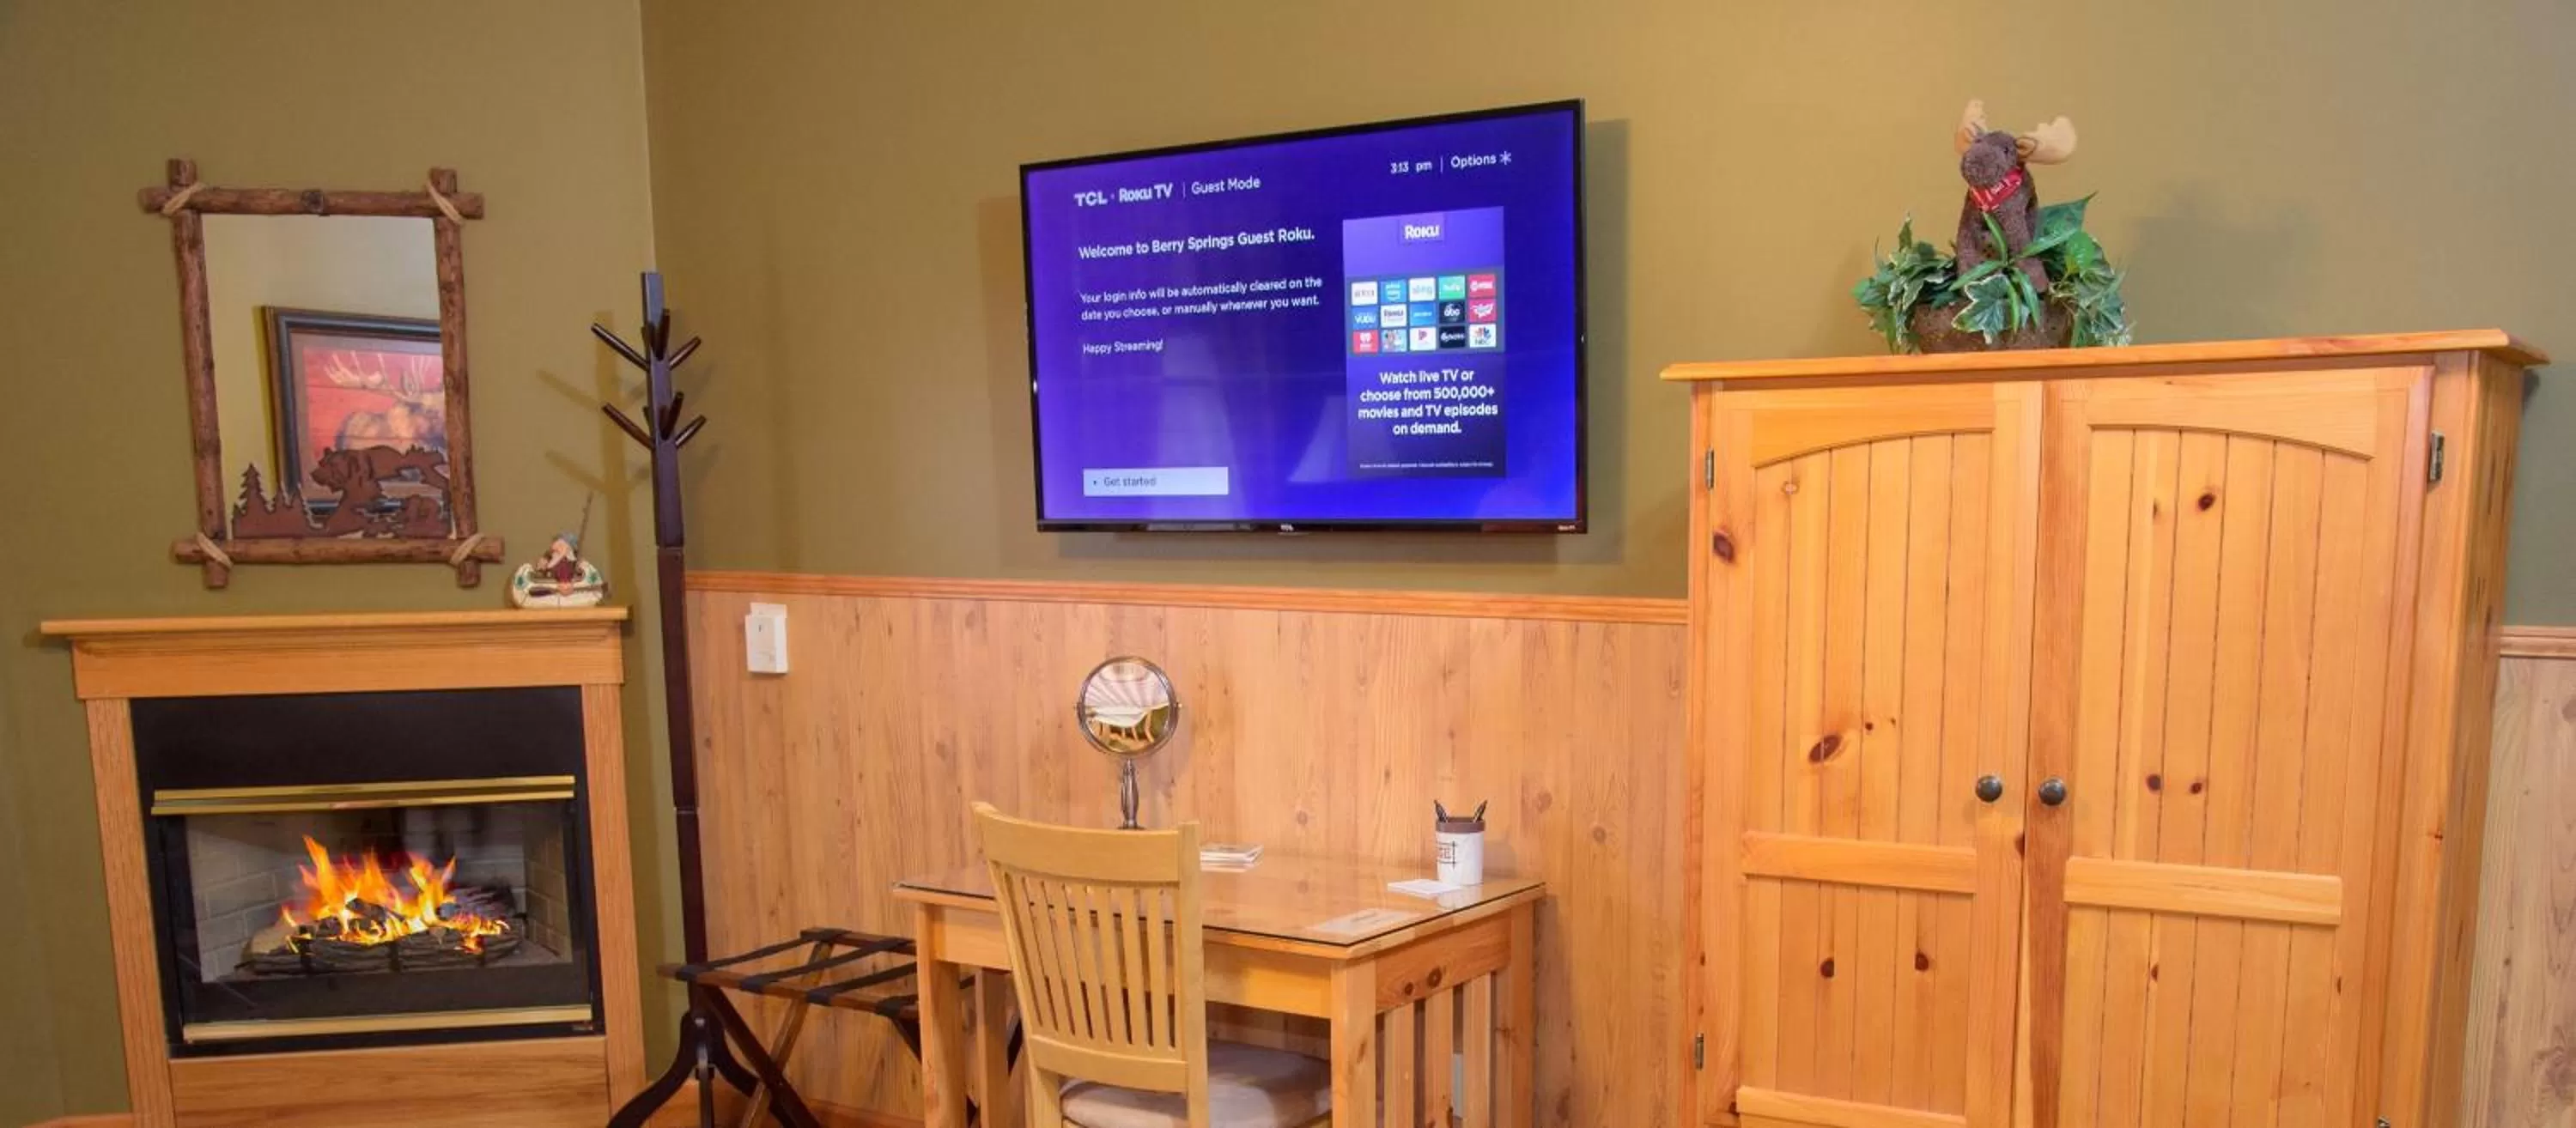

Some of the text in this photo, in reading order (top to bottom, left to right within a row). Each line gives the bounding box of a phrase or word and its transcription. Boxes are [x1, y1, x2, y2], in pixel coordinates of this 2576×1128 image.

[1416, 161, 1432, 173] pm
[1450, 154, 1497, 170] Options
[1191, 176, 1261, 195] Guest Mode
[1074, 191, 1108, 207] TCL
[1154, 184, 1173, 199] TV
[1079, 226, 1315, 259] Welcome to Berry Springs Guest Roku.
[1080, 276, 1322, 304] Your login info will be automatically cleared on the
[1081, 294, 1320, 322] date you choose, or manually whenever you want.
[1082, 339, 1163, 355] Happy Streaming!
[1379, 369, 1474, 385] Watch live TV or
[1360, 386, 1495, 402] choose from 500,000+
[1358, 403, 1498, 419] movies and TV episodes
[1393, 421, 1461, 435] on demand.
[1103, 476, 1157, 488] Get started
